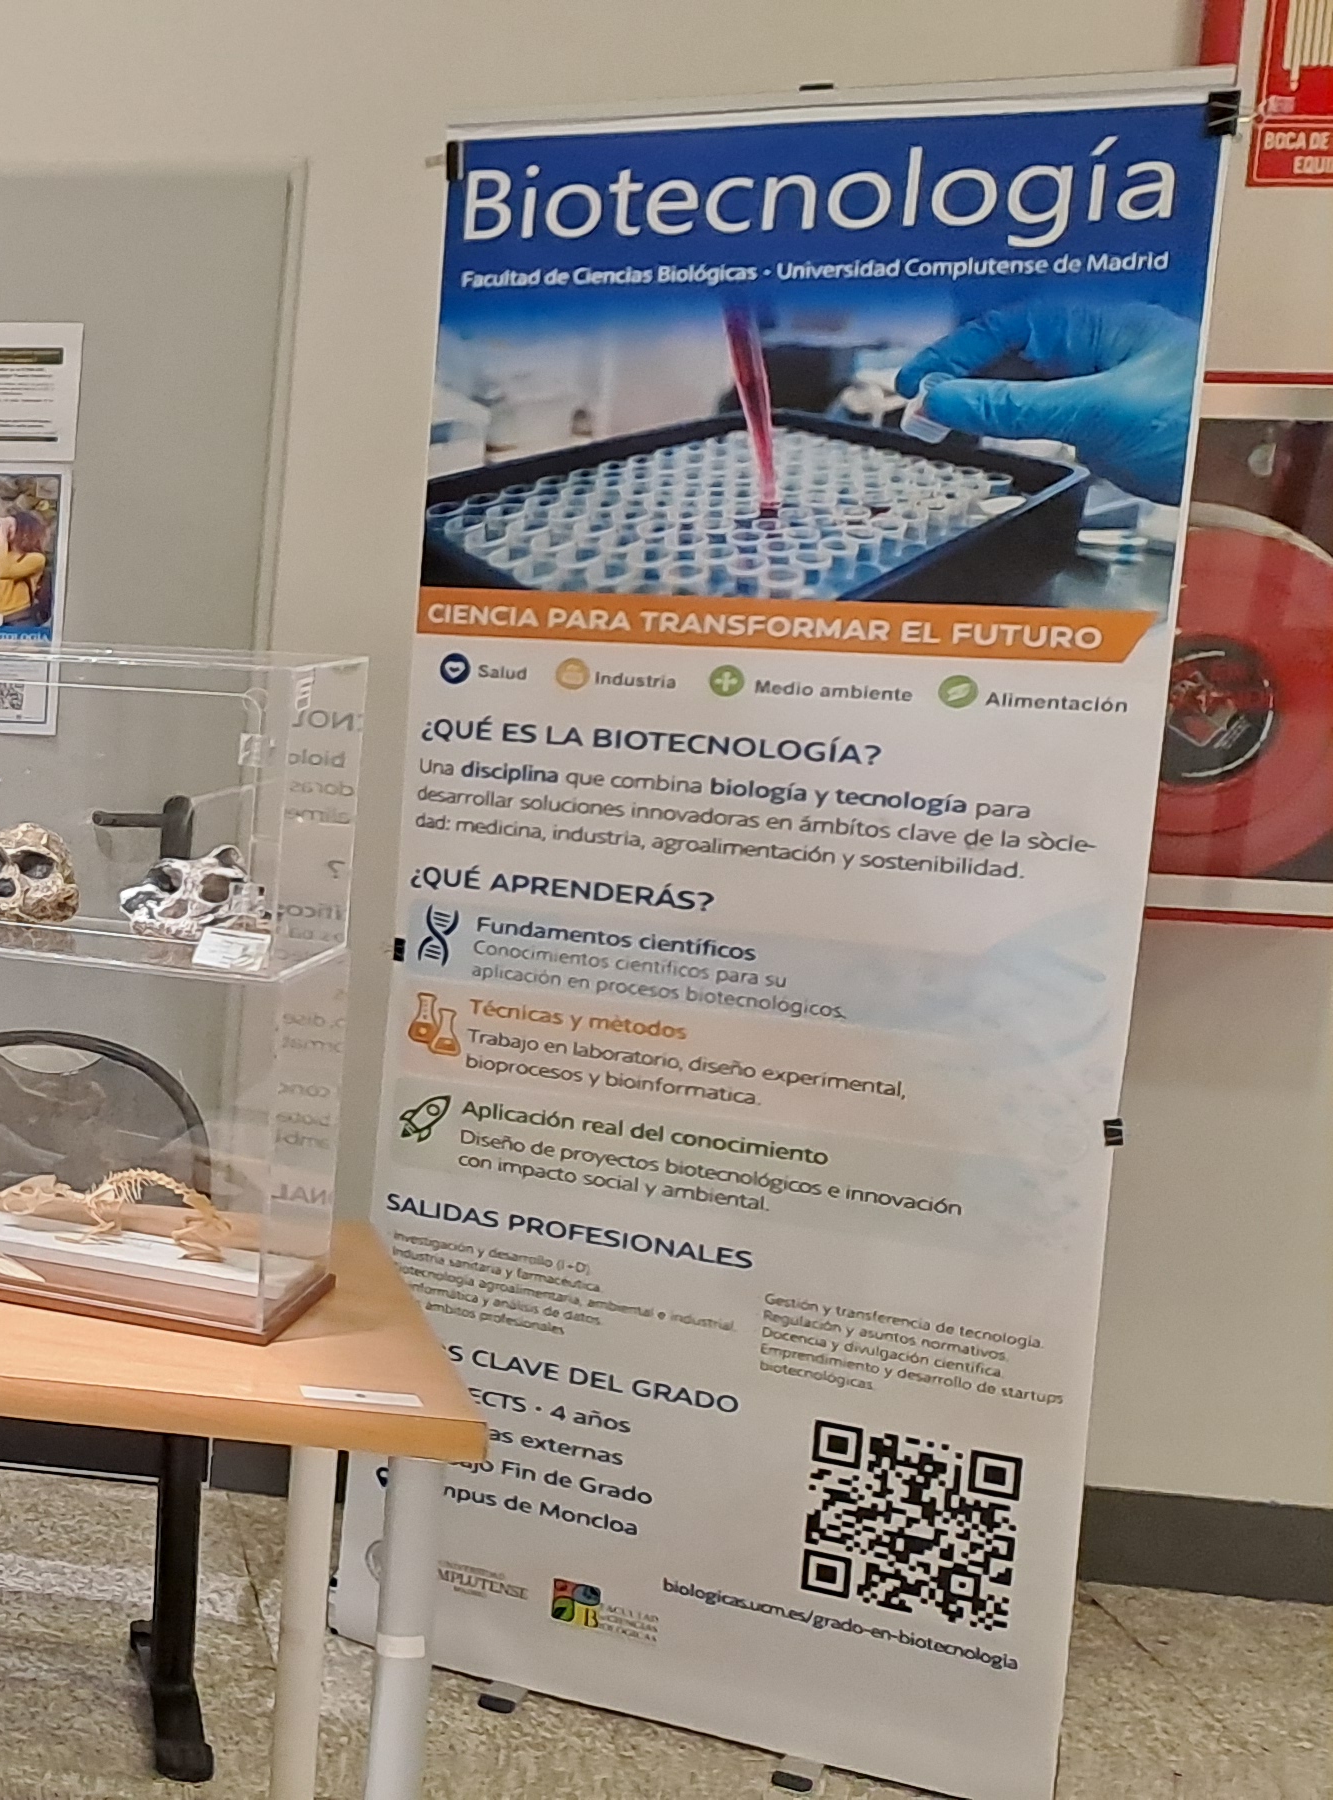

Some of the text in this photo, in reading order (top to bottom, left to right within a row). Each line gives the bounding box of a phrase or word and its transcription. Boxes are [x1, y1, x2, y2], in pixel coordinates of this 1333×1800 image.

[1263, 131, 1330, 150] BOCA DE
[461, 136, 1178, 249] Biotecnología
[460, 250, 1169, 288] Facultad de Ciencias Biológicas Universidad Complutense de Madrid
[426, 602, 1102, 650] CIENCIA PARA TRANSFORMAR EL FUTURO
[476, 662, 1131, 715] Salud Industria Medio ambiente Alimentación
[420, 714, 882, 766] ¿QUÉ ES LA BIOTECNOLOGÍA?
[419, 757, 1031, 821] Una disciplina que combina biología y tecnología para
[416, 785, 514, 809] desarrollar
[519, 794, 626, 818] soluciones
[630, 801, 760, 829] innovadoras
[765, 816, 793, 831] en
[896, 822, 958, 845] clave
[962, 828, 994, 850] de
[1000, 829, 1021, 848] la
[414, 812, 1025, 879] dad: medicina, industria, agroalimentación y sostenibilidad.
[409, 864, 715, 912] ¿QUÉ APRENDERÁS?
[476, 915, 757, 962] Fundamentos científicos
[470, 963, 562, 987] aplicación
[566, 976, 590, 990] en
[595, 979, 680, 1000] procesos
[472, 939, 787, 988] Conocimientos científicos para su
[468, 997, 564, 1025] Técnicas
[569, 1013, 583, 1032] y
[464, 1052, 601, 1088] bioprocesos y
[466, 1027, 906, 1101] Trabajo en laboratorio, diseño experimental,
[460, 1100, 829, 1166] Aplicación real del conocimiento
[457, 1154, 770, 1212] con impacto social y ambiental.
[460, 1128, 962, 1216] Diseño de proyectos biotecnológicos e innovación
[386, 1192, 753, 1269] SALIDAS PROFESIONALES
[471, 1349, 560, 1382] CLAVE
[568, 1366, 624, 1394] DEL
[631, 1378, 739, 1413] GRADO
[549, 1405, 566, 1421] 4
[572, 1409, 631, 1433] años
[520, 1434, 624, 1466] externas
[501, 1460, 537, 1482] Fin
[543, 1469, 574, 1489] de
[579, 1476, 654, 1505] Grado
[502, 1494, 638, 1536] de Moncloa
